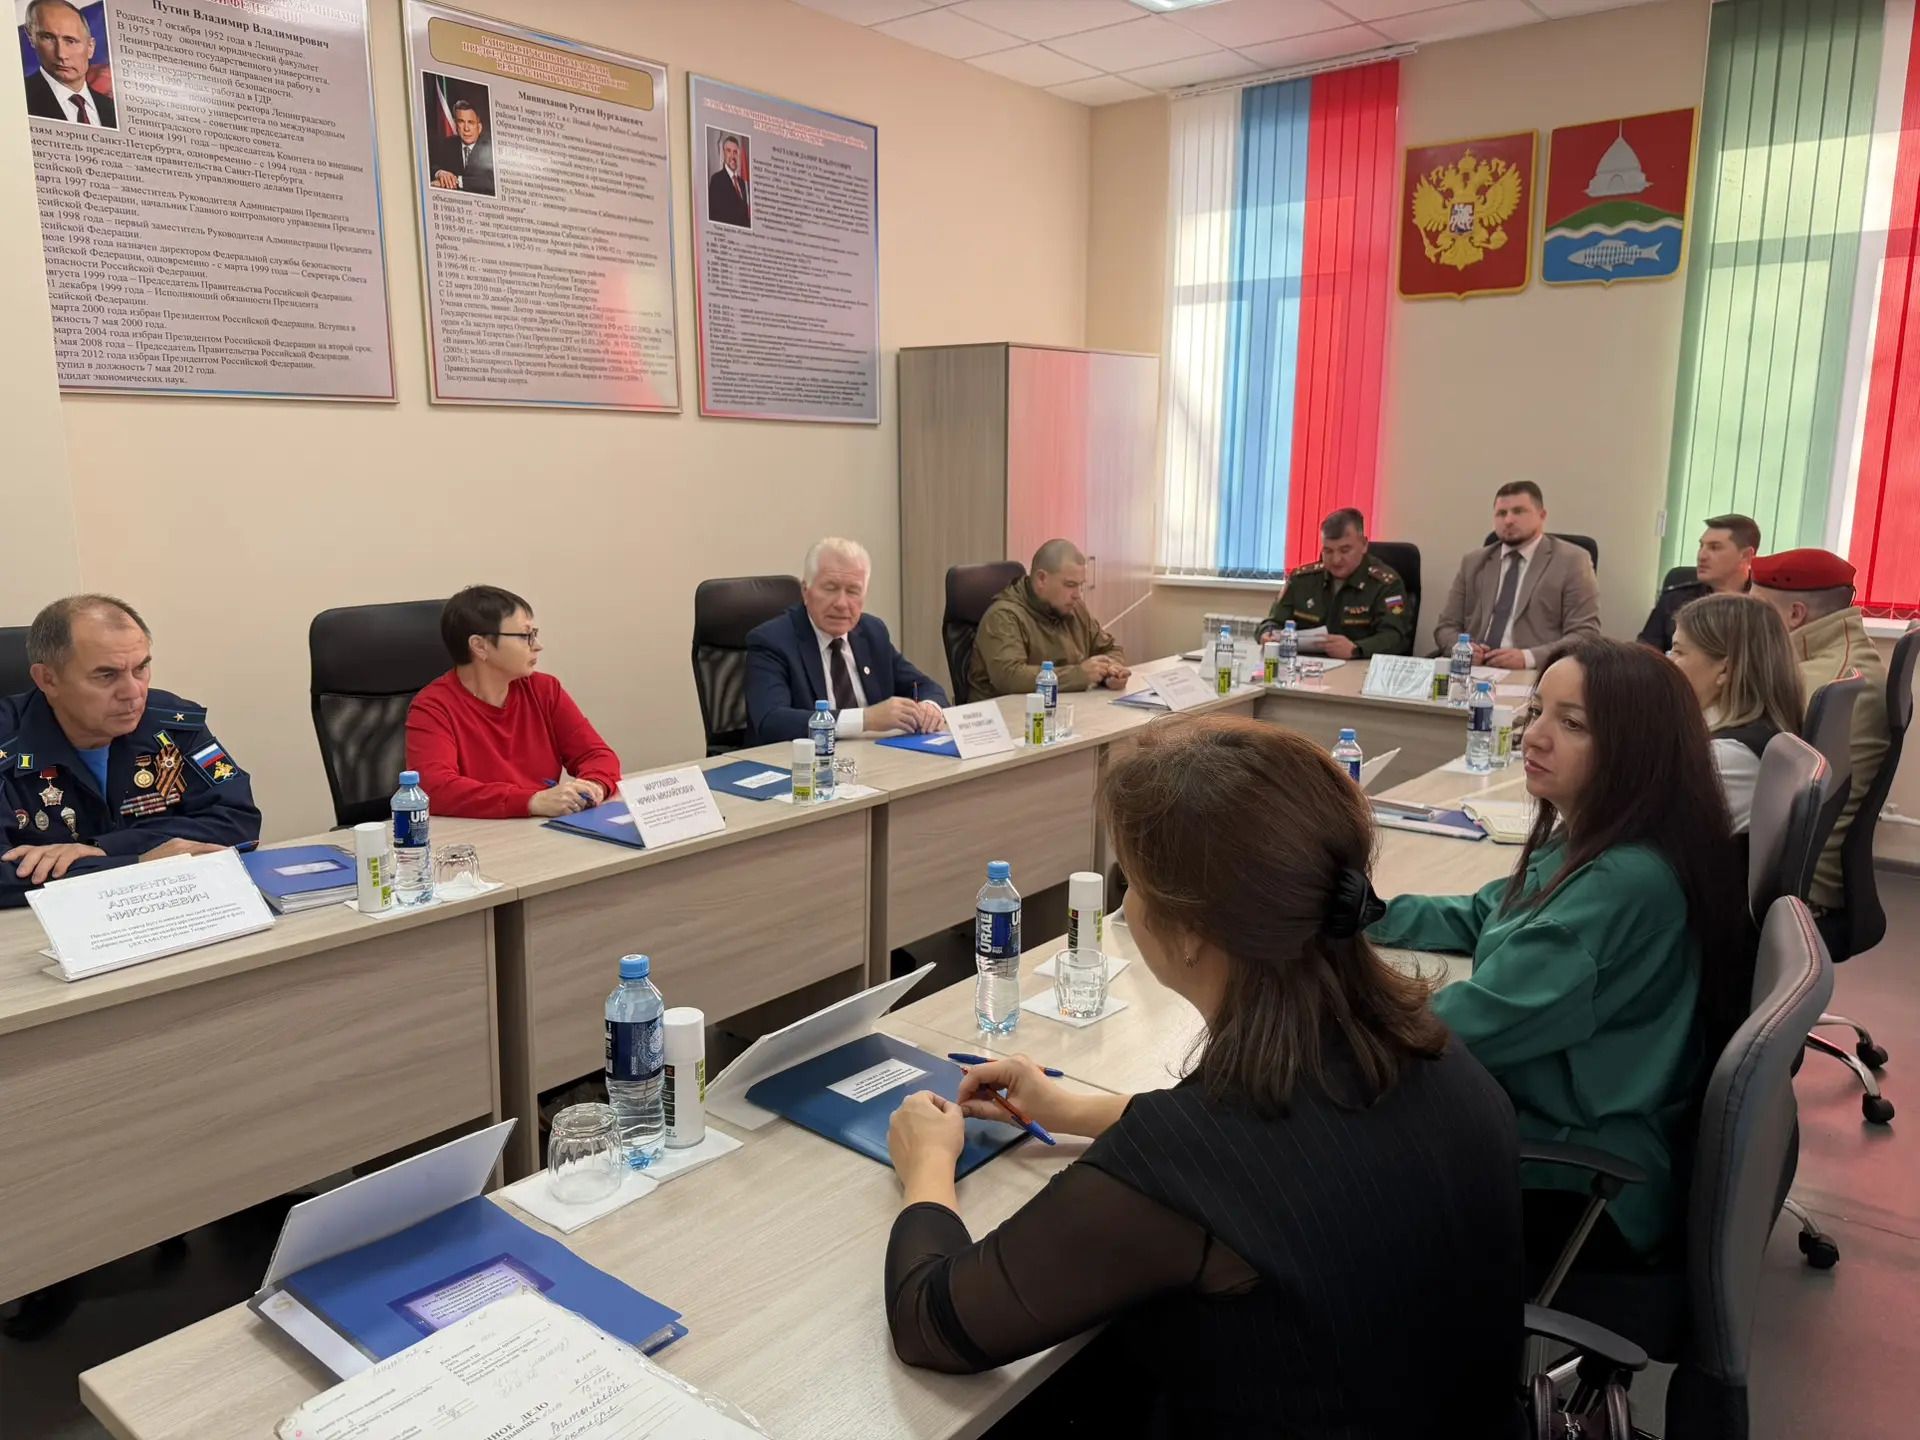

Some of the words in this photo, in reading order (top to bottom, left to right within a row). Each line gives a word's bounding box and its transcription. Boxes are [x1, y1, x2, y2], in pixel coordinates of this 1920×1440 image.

[115, 8, 155, 26] Родился
[164, 19, 201, 38] октября
[204, 28, 224, 41] 1952
[226, 35, 245, 46] года
[152, 0, 189, 18] Путин
[192, 8, 249, 32] Владимир
[252, 22, 328, 50] Владимирович
[117, 32, 194, 58] Ленинградского
[195, 50, 272, 74] государственного
[128, 22, 150, 36] 1975
[152, 30, 173, 42] году
[178, 35, 216, 50] окончил
[218, 43, 276, 64] юридический
[277, 55, 319, 74] факультет
[135, 49, 207, 72] распределению
[208, 62, 227, 74] был
[228, 68, 273, 85] направлен
[285, 78, 314, 93] работу
[210, 84, 245, 101] работал
[207, 108, 266, 126] университета
[236, 102, 270, 117] ректора
[568, 101, 595, 116] Рустам
[126, 114, 202, 137] Ленинградского
[203, 129, 251, 145] городского
[175, 113, 200, 124] затем
[208, 118, 248, 132] советник
[55, 129, 89, 143] мэрии
[186, 149, 252, 167] одновременно
[267, 160, 286, 171] 1994
[138, 129, 164, 140] июня
[167, 132, 186, 144] 1991
[190, 137, 210, 148] года
[218, 143, 275, 160] председатель
[85, 145, 152, 163] председателя
[154, 155, 222, 174] правительства
[74, 153, 98, 165] 1996
[134, 163, 193, 178] заместитель
[194, 172, 261, 190] управляющего
[262, 179, 293, 193] делами
[64, 175, 87, 187] 1997
[120, 185, 177, 201] заместитель
[178, 190, 236, 208] Руководителя
[57, 209, 80, 221] 1998
[113, 216, 149, 230] первый
[140, 198, 187, 211] начальник
[189, 202, 228, 216] Главного
[229, 207, 285, 225] контрольного
[68, 233, 90, 245] 1998
[115, 240, 157, 252] назначен
[158, 245, 210, 259] директором
[212, 249, 268, 264] Федеральной
[268, 255, 300, 268] службы
[100, 259, 154, 273] Российской
[223, 262, 248, 273] марта
[250, 263, 269, 273] 1999
[57, 277, 97, 292] декабря
[100, 282, 122, 292] 1999
[154, 285, 218, 300] Исполняющий
[219, 291, 271, 305] обязанности
[83, 269, 105, 280] 1999
[137, 274, 199, 290] Председатель
[200, 280, 262, 295] Правительства
[50, 303, 80, 314] марта
[81, 303, 105, 314] 2000
[106, 307, 127, 316] года
[128, 307, 161, 319] избран
[162, 309, 220, 323] Президентом
[221, 314, 269, 325] Российской
[120, 317, 143, 328] 2000
[53, 326, 82, 336] марта
[84, 326, 107, 336] 2004
[131, 329, 163, 341] избран
[58, 334, 77, 345] мая
[79, 337, 103, 347] 2008
[135, 339, 196, 354] Председатель
[80, 348, 104, 358] 2012
[127, 349, 160, 363] избран
[161, 352, 219, 365] Президентом
[94, 362, 145, 371] должность
[172, 363, 194, 373] 2012
[92, 373, 162, 383] экономических
[105, 882, 199, 910] АЛЕКСАНДР
[105, 891, 210, 922] НИКОЛАЕВИЧ
[980, 914, 992, 954] URAL
[520, 1402, 549, 1422] ДЕЛО
